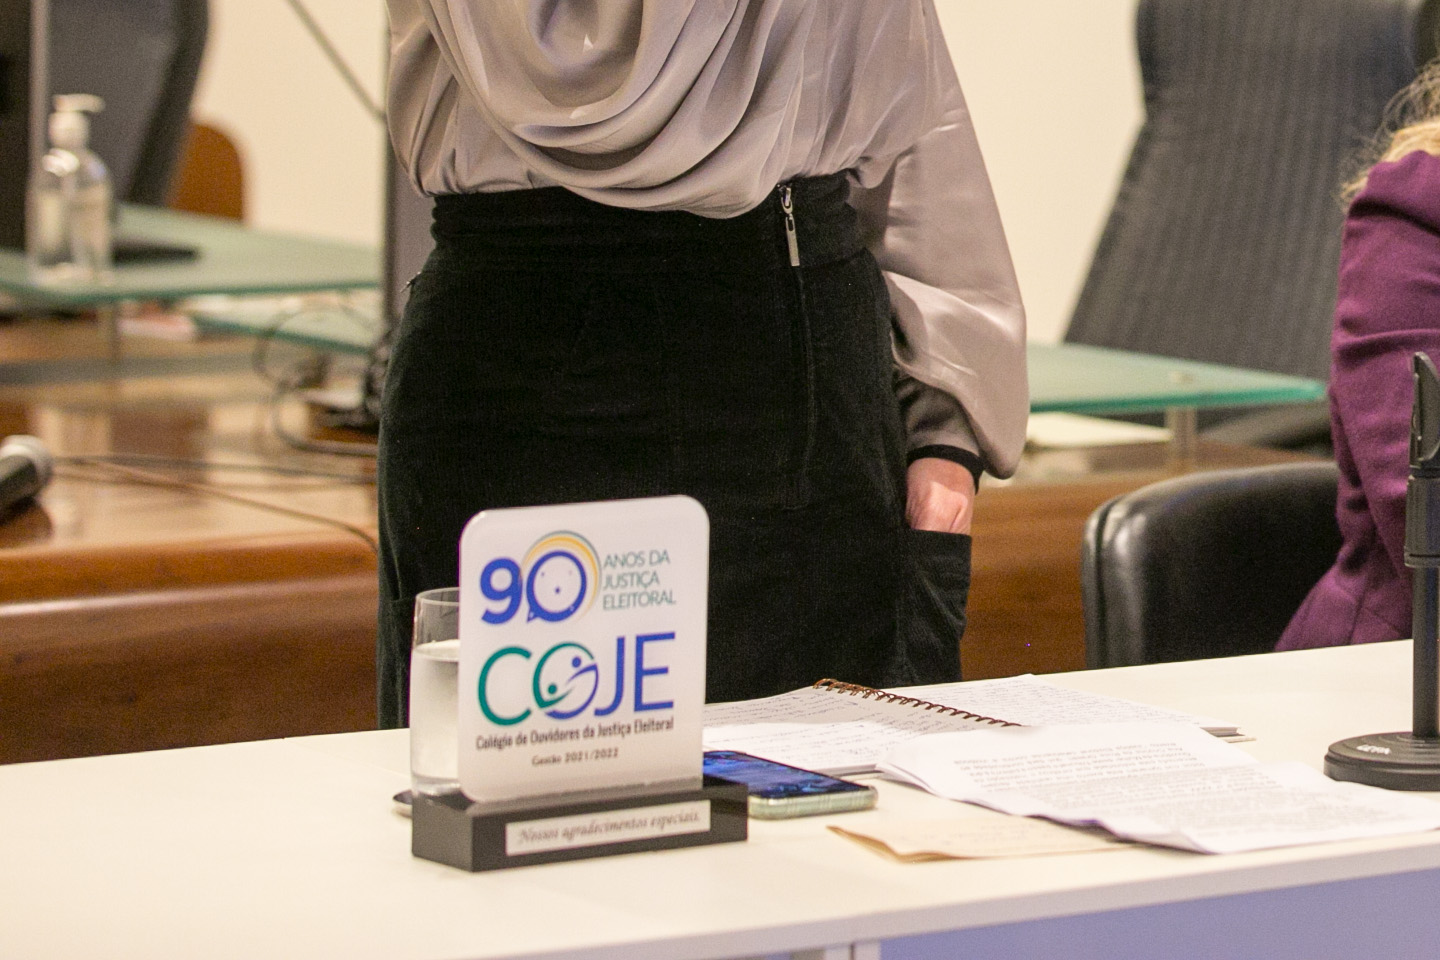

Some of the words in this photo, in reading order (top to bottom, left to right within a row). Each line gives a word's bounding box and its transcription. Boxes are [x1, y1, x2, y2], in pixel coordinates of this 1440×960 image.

[603, 550, 646, 569] ANOS
[649, 549, 671, 565] DA
[480, 550, 588, 625] 90
[603, 570, 660, 590] JUSTIÇA
[603, 589, 676, 611] ELEITORAL
[478, 632, 676, 727] COJE
[476, 733, 513, 751] Colégio
[515, 731, 527, 746] de
[530, 725, 580, 744] Ouvidores
[582, 724, 595, 739] da
[597, 720, 631, 738] Justiça
[634, 716, 675, 734] Eleitoral
[564, 747, 619, 764] 2021/2022
